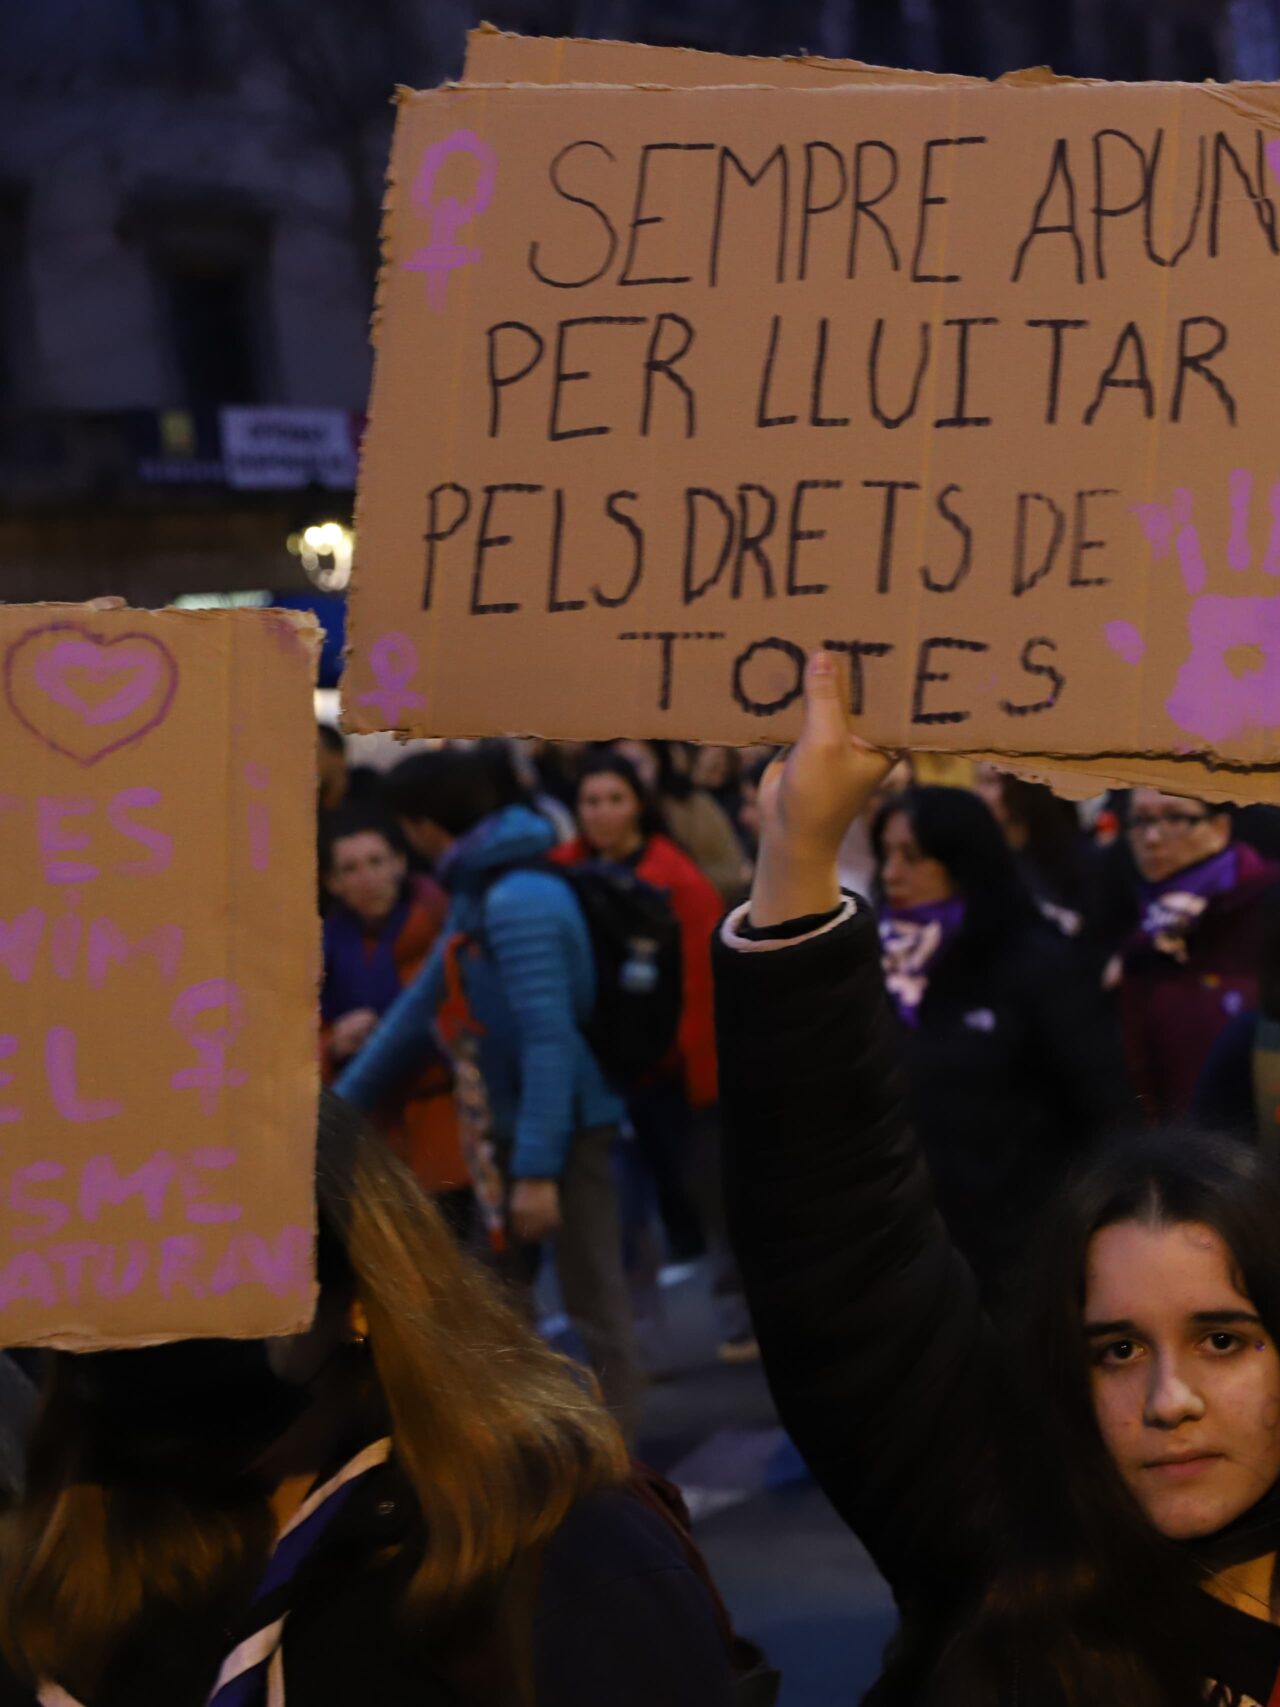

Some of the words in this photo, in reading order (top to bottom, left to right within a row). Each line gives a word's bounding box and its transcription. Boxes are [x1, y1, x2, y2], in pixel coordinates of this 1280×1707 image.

[528, 139, 987, 289] SEMPRE
[485, 312, 695, 442] PER
[756, 314, 1237, 430] LLUITAR
[421, 480, 645, 616] PELS
[682, 478, 973, 606] DRETS
[1010, 487, 1118, 598] DE
[616, 630, 1066, 726] TOTES
[0, 785, 174, 884] ES
